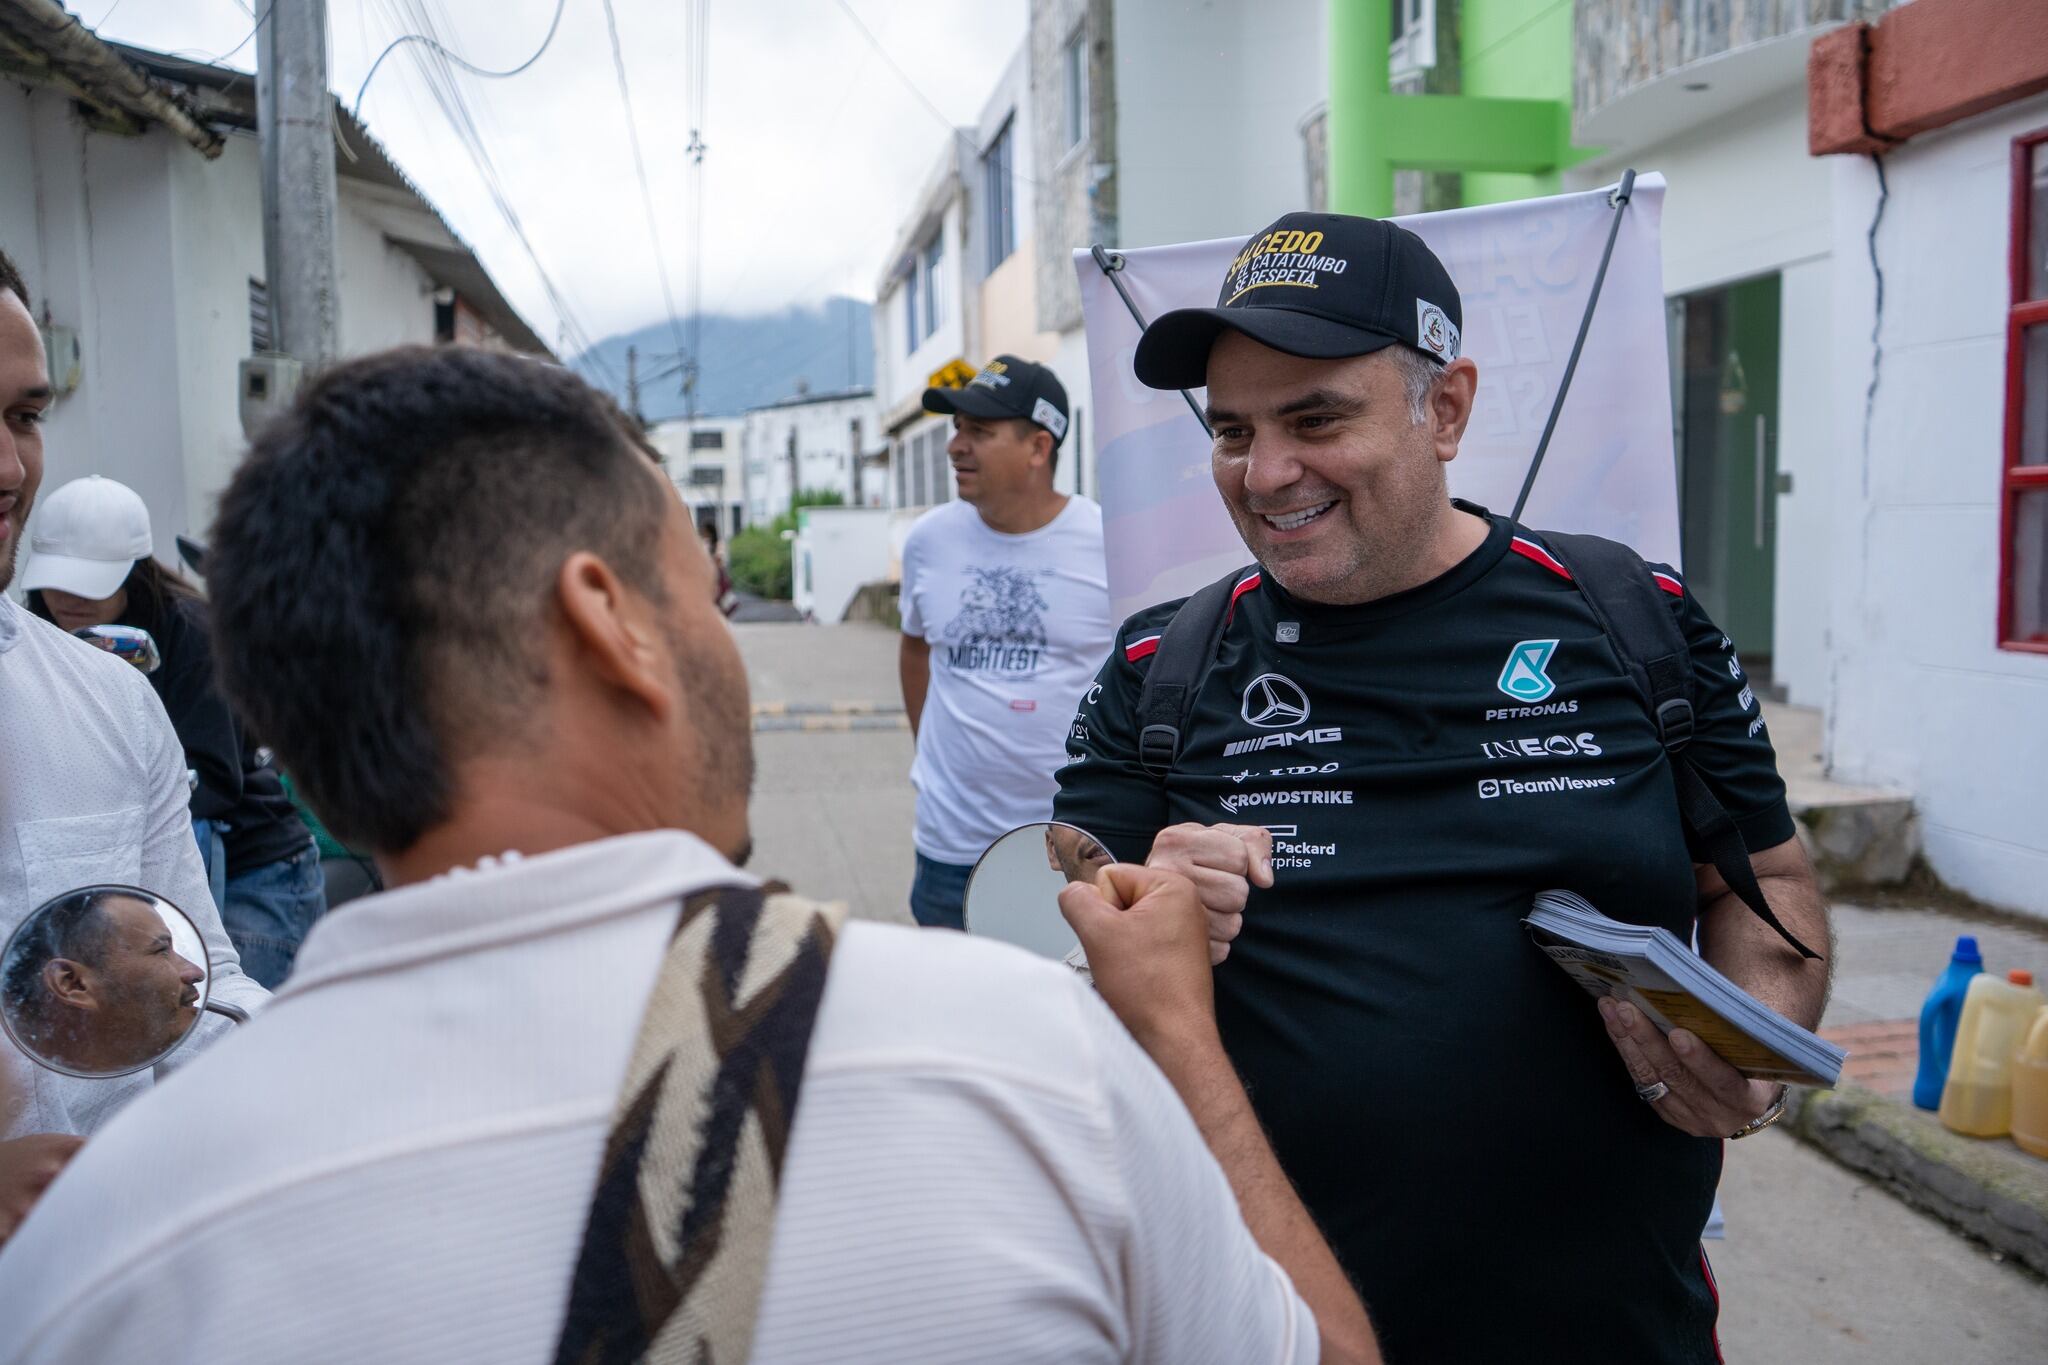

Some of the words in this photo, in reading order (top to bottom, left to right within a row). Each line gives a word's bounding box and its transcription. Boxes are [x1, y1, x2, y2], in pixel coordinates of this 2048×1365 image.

[1227, 230, 1324, 283] SALCEDO
[1237, 261, 1249, 280] EL
[1251, 253, 1347, 274] CATATUMBO
[1232, 274, 1249, 296] SE
[1248, 268, 1316, 287] RESPETA
[947, 645, 1040, 670] MIGHTIEST
[1485, 700, 1579, 721] PETRONAS
[1259, 728, 1343, 751] AMG
[1480, 732, 1603, 760] INEOS
[1500, 776, 1617, 794] TeamViewer
[1228, 790, 1354, 807] CROWDSTRIKE
[1276, 841, 1336, 855] Packard
